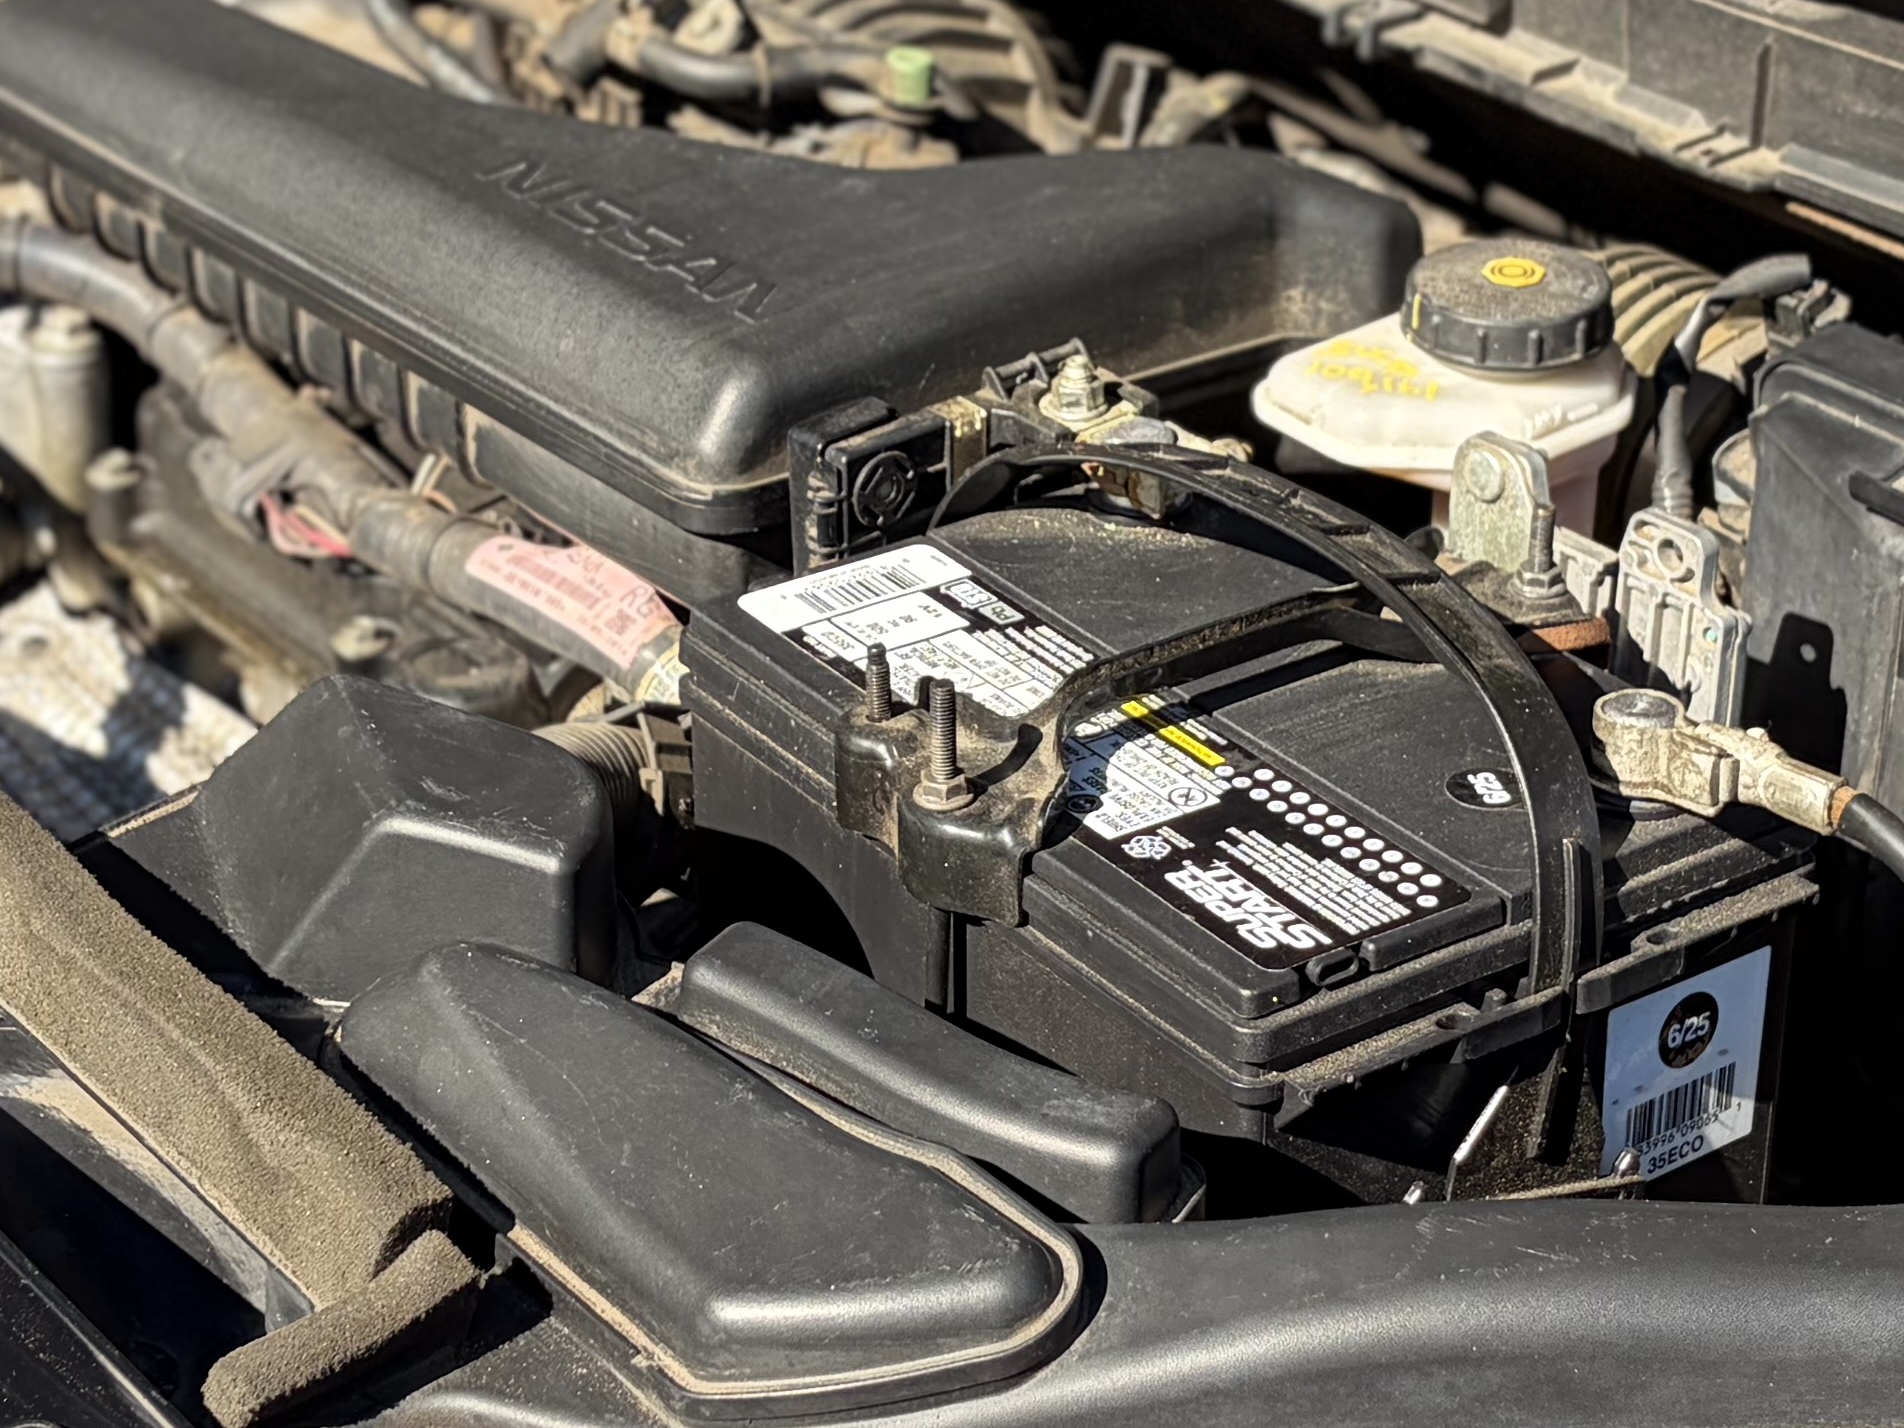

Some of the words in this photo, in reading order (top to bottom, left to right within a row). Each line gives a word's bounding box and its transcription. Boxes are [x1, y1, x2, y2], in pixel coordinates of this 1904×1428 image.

[477, 157, 784, 323] NISSAN
[991, 606, 1015, 621] Pb
[1467, 772, 1512, 804] 6/25
[1164, 870, 1277, 949] SUPER
[1204, 866, 1333, 950] START
[1667, 1011, 1711, 1049] 6/25
[1647, 1134, 1704, 1174] 35ECO
